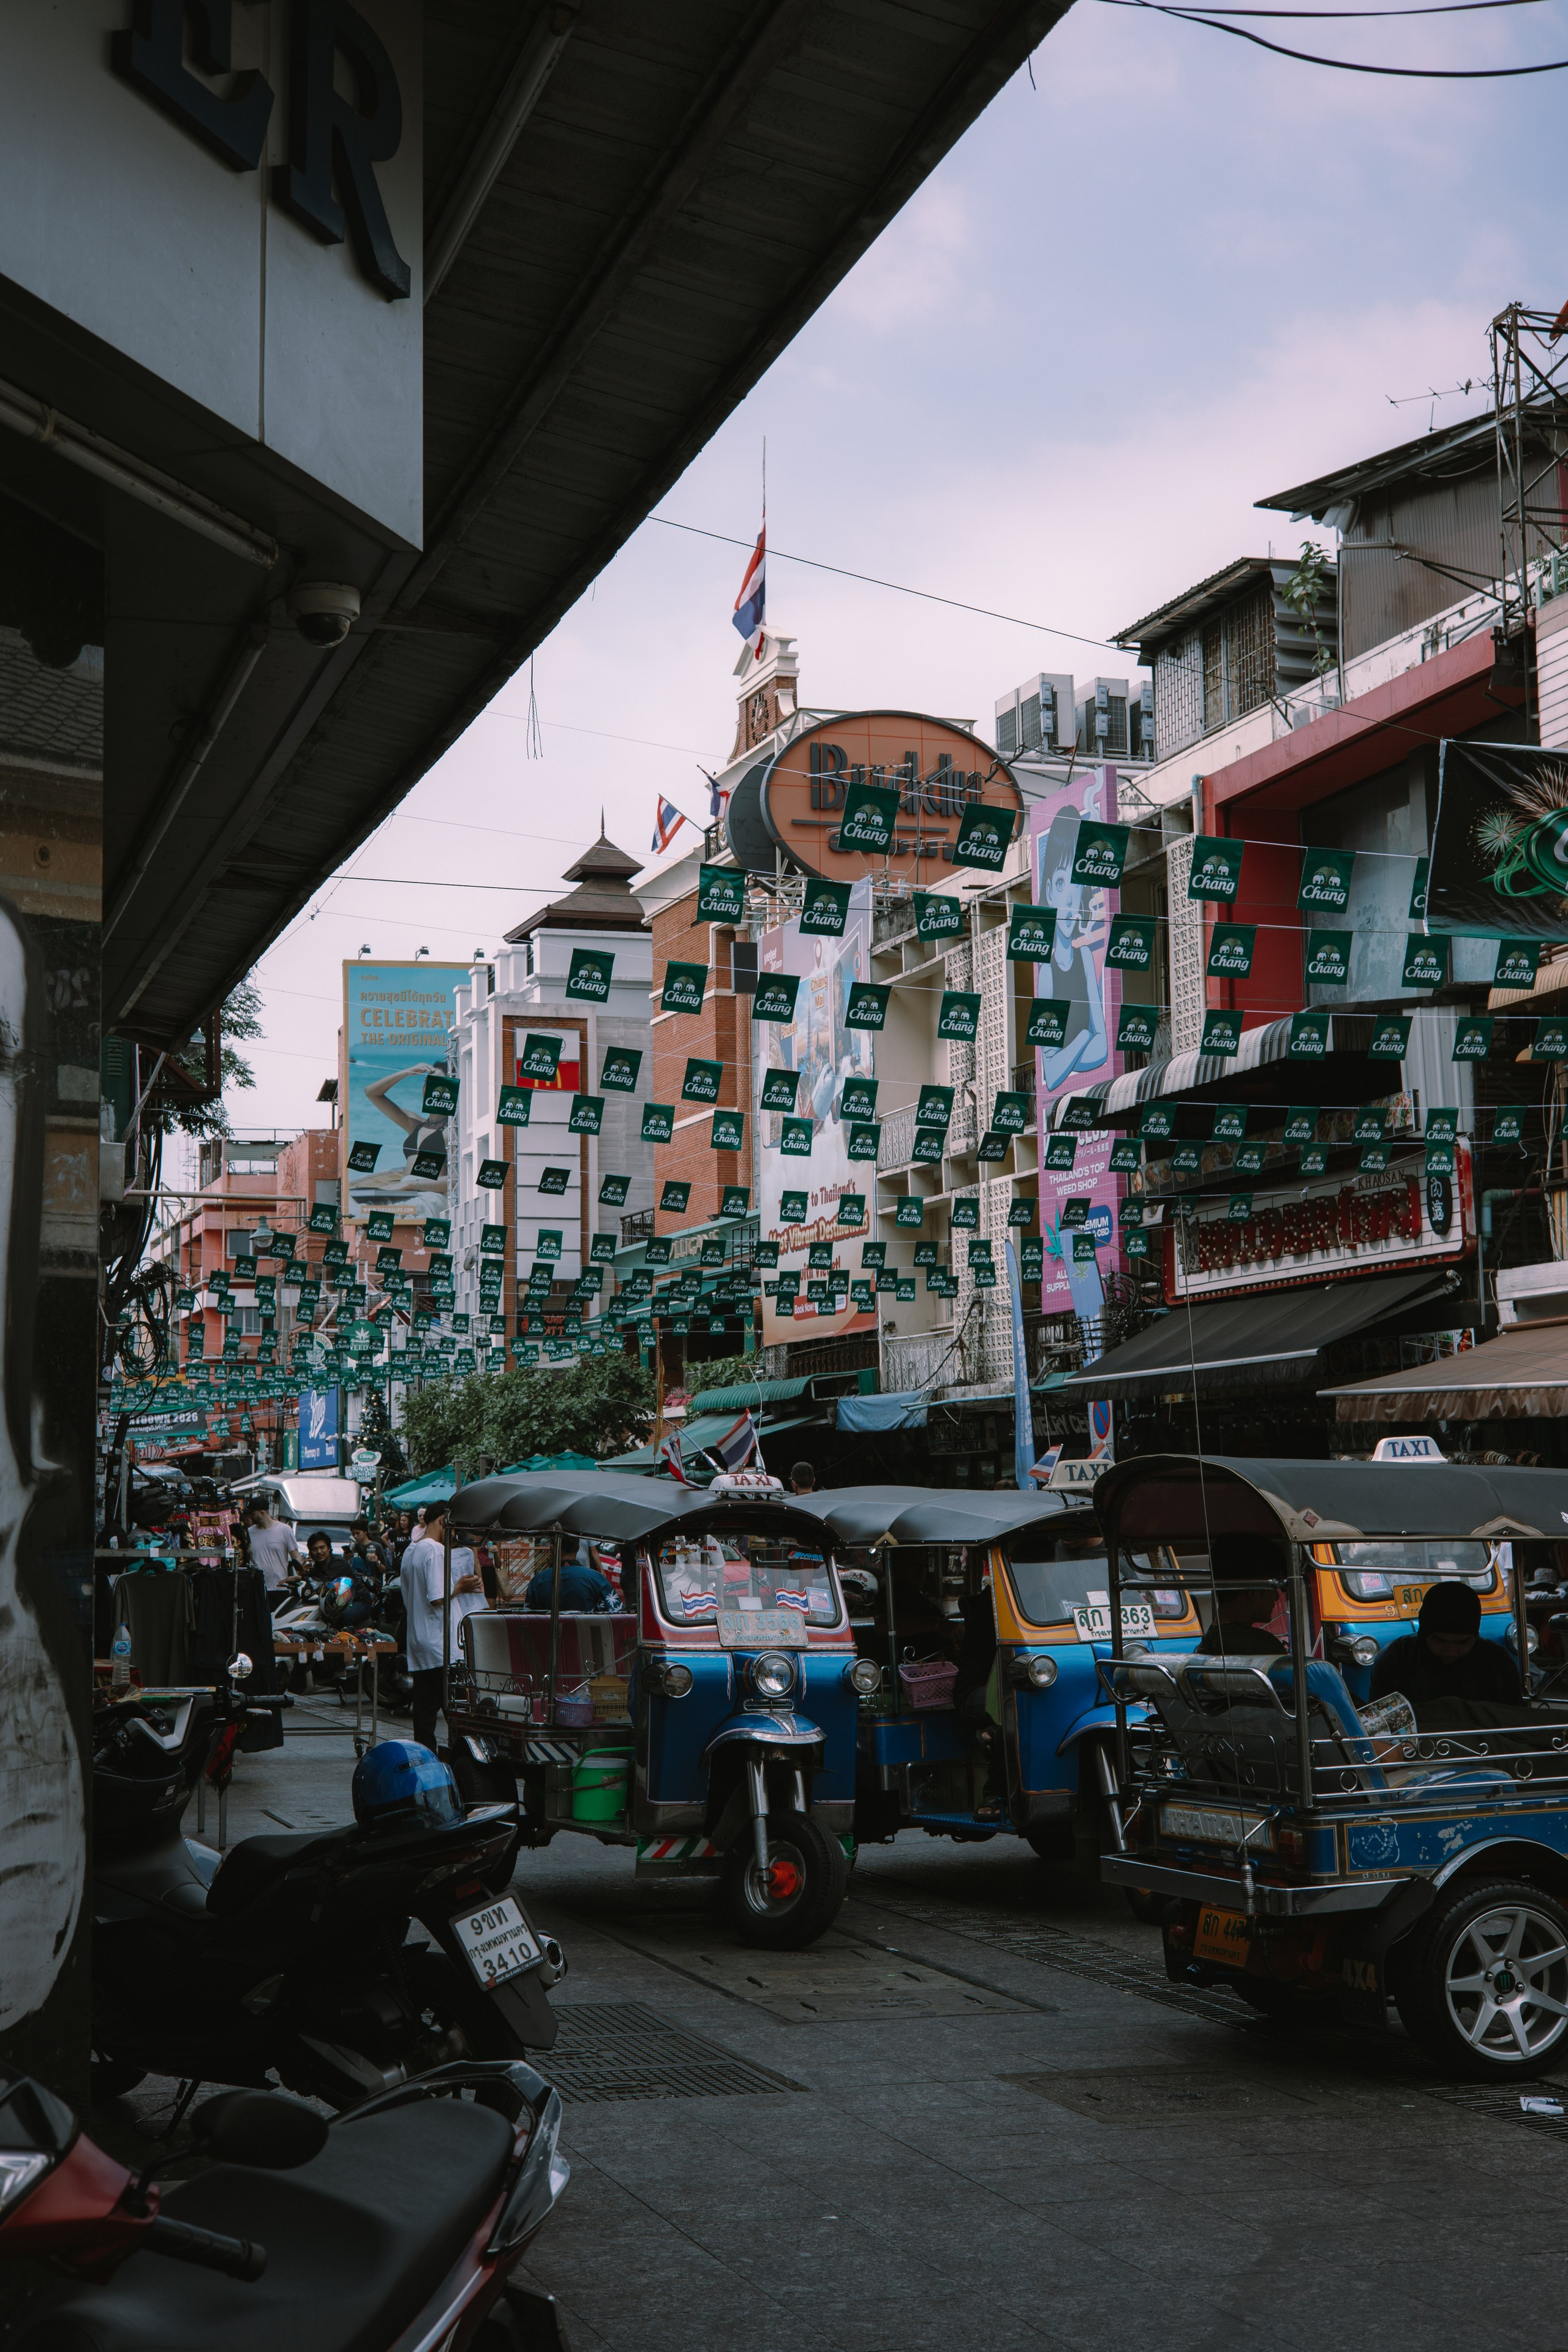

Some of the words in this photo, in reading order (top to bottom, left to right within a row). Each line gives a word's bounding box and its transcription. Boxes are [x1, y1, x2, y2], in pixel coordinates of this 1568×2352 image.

[844, 822, 888, 845] Chang
[958, 840, 1003, 862] Chang
[1076, 859, 1120, 880] Chang
[1192, 875, 1235, 894] Chang
[1302, 885, 1346, 904] Chang
[701, 897, 739, 914] Chang
[802, 910, 842, 929] Chang
[920, 917, 959, 931] Chang
[1011, 938, 1049, 955] Chang
[1110, 946, 1148, 962] Chang
[1211, 954, 1249, 971] Chang
[1308, 962, 1344, 976] Chang
[1405, 967, 1441, 981] Chang
[1497, 968, 1533, 982] Chang
[570, 976, 606, 994] Chang
[811, 975, 827, 992] Chiang
[665, 991, 700, 1006] Chang
[815, 993, 824, 1008] Mai
[756, 1000, 791, 1015] Chang
[850, 1009, 883, 1023] Chang
[781, 1023, 797, 1039] Phuket
[941, 1019, 974, 1034] Chang
[361, 1033, 384, 1045] THE
[389, 1033, 447, 1046] ORIGINAL
[1029, 1027, 1063, 1040] Chang
[1119, 1032, 1152, 1045] Chang
[1204, 1037, 1237, 1050] Chang
[1291, 1041, 1323, 1054] Chang
[1373, 1041, 1404, 1053] Chang
[1456, 1044, 1486, 1055] Chang
[1535, 1042, 1566, 1054] Chang
[522, 1060, 557, 1077] Chang
[601, 1071, 633, 1085] Chang
[685, 1083, 716, 1097] Chang
[425, 1098, 454, 1110] Chang
[764, 1093, 793, 1106] Chang
[500, 1109, 527, 1121] Chang
[843, 1102, 872, 1115] Chang
[919, 1109, 948, 1122] Chang
[995, 1115, 1025, 1129] Chang
[571, 1117, 598, 1129] Chang
[643, 1126, 670, 1137] Chang
[1142, 1125, 1169, 1135] Chang
[1215, 1126, 1242, 1137] Chang
[1285, 1129, 1311, 1139] Chang
[1355, 1130, 1381, 1139] Chang
[1427, 1131, 1453, 1141] Chang
[1494, 1128, 1519, 1137] Chang
[714, 1133, 739, 1145] Chang
[783, 1140, 809, 1151] Chang
[850, 1145, 876, 1155] Chang
[915, 1147, 941, 1158] Chang
[1048, 1155, 1074, 1169] Chang
[1109, 1156, 1136, 1168] Chang
[1174, 1158, 1197, 1167] Chang
[1237, 1159, 1260, 1169] Chang
[1361, 1160, 1385, 1170] Chang
[1427, 1163, 1451, 1172] Chang
[1049, 1166, 1090, 1185] THAILAND'S
[1090, 1162, 1105, 1173] TOP
[1358, 1169, 1404, 1189] KHAOSAN
[811, 1191, 818, 1207] to
[820, 1178, 856, 1205] Thailand's
[1057, 1183, 1077, 1196] WEED
[1077, 1177, 1098, 1191] SHOP
[600, 1191, 626, 1204] Chang
[723, 1204, 748, 1216] Chang
[782, 1209, 805, 1218] Chang
[837, 1210, 862, 1224] Chang
[898, 1214, 921, 1223] Chang
[954, 1215, 976, 1224] Chang
[367, 1229, 390, 1240] Chang
[425, 1235, 447, 1245] Chang
[788, 1222, 818, 1248] Vibrant
[483, 1241, 503, 1250] Chang
[538, 1247, 559, 1256] Chang
[592, 1250, 613, 1259] Chang
[794, 1305, 805, 1314] Book
[805, 1302, 815, 1312] Now!
[173, 1412, 198, 1423] 2026
[1388, 1440, 1431, 1457] TAXI
[729, 1475, 773, 1487] TAXI
[1108, 1606, 1150, 1624] 363
[1385, 1605, 1396, 1617] 9
[755, 1613, 801, 1630] 3566
[398, 1758, 424, 1771] INDEX
[470, 1905, 508, 1936] 9ขท
[469, 1923, 528, 1959] กรุงเทพมหานคร
[483, 1942, 532, 1977] 3410
